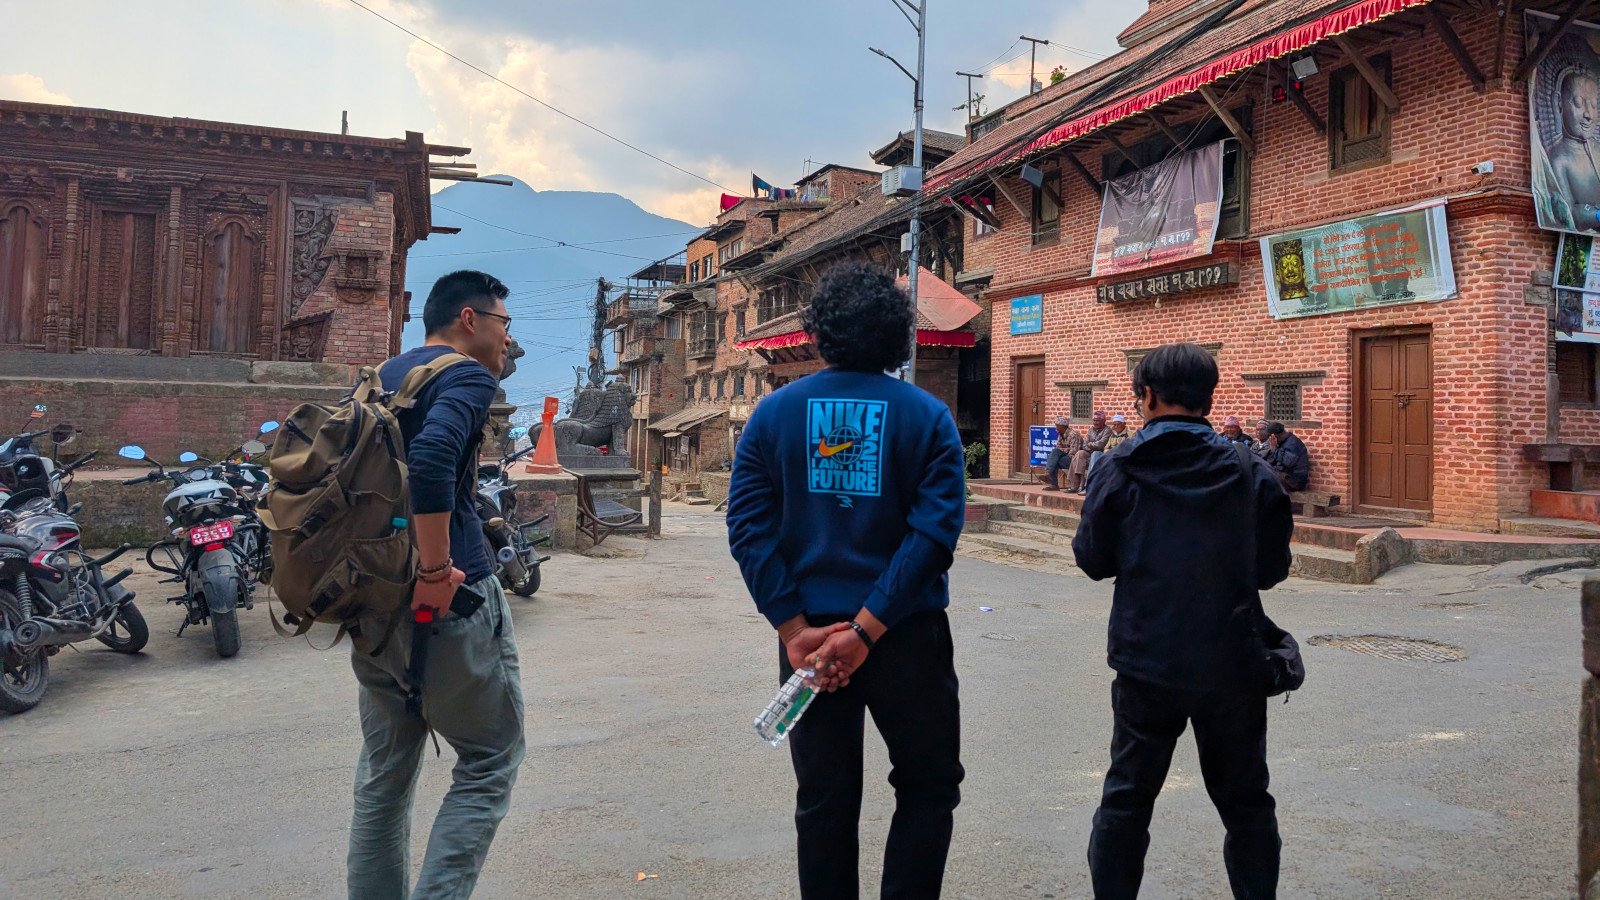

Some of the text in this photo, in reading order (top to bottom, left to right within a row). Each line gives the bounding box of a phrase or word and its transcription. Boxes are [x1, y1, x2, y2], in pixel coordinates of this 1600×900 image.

[812, 402, 881, 441] NIKE
[811, 459, 816, 469] I
[812, 470, 877, 491] FUTURE
